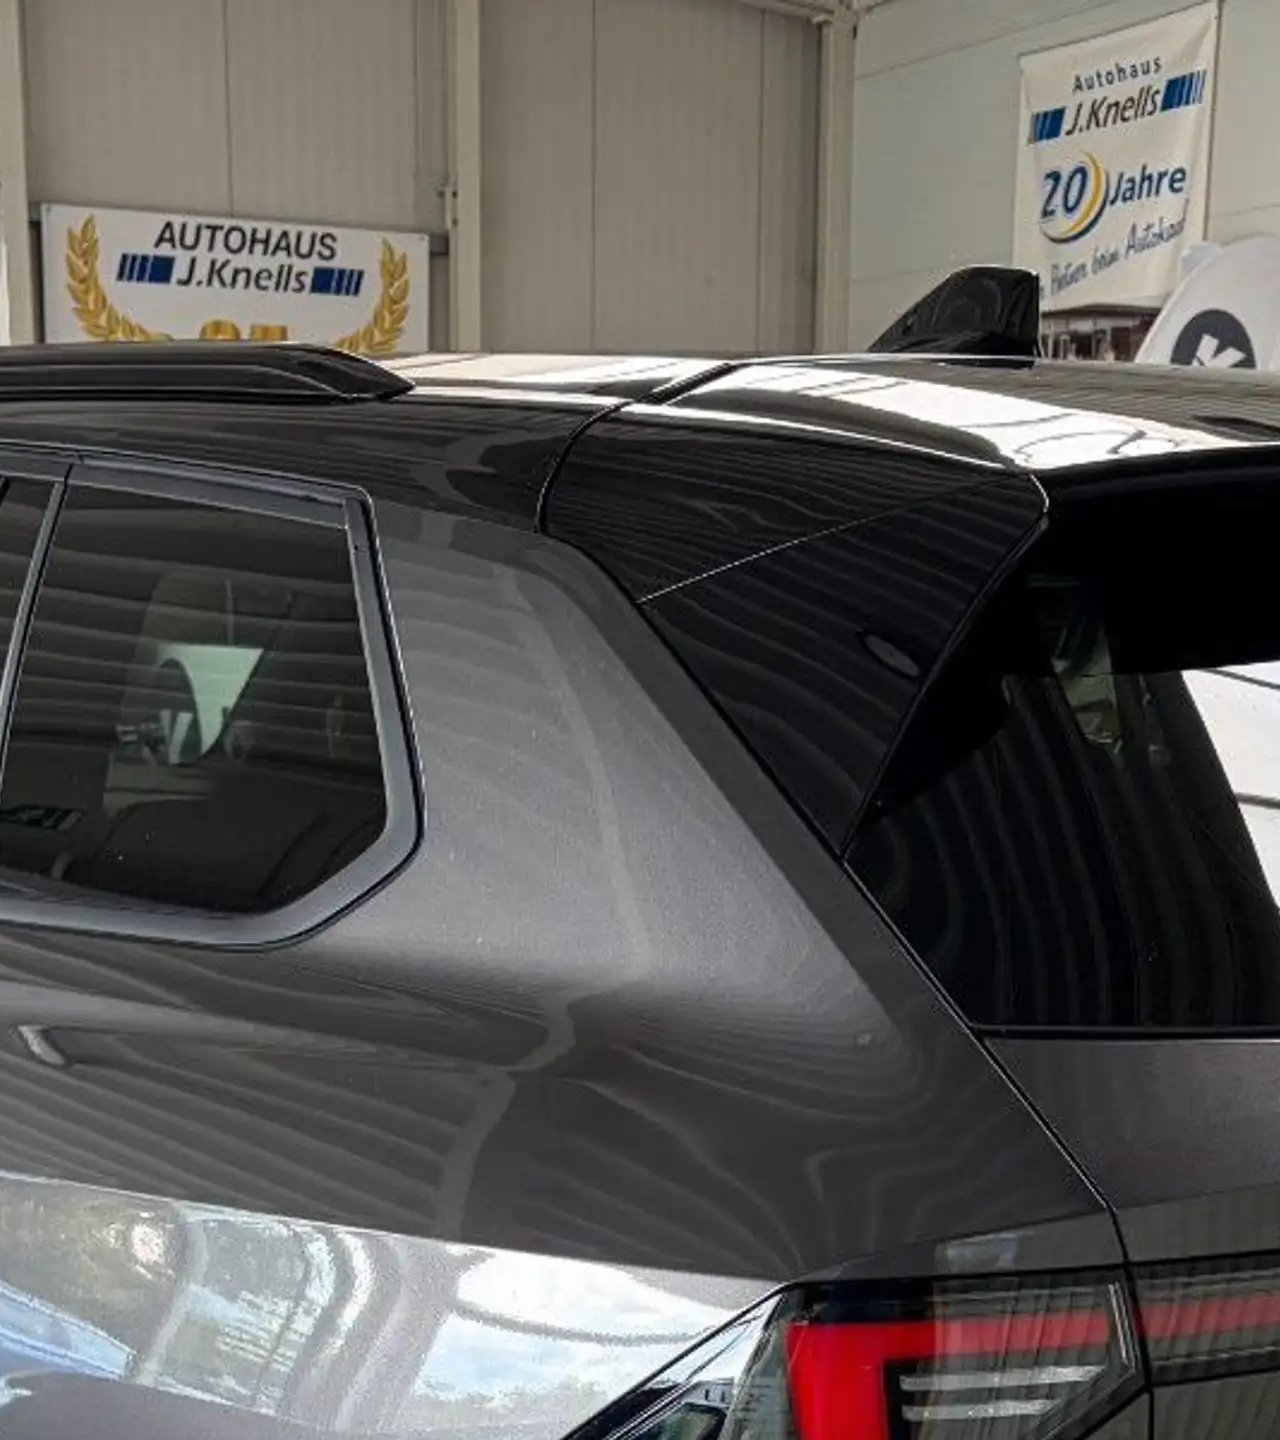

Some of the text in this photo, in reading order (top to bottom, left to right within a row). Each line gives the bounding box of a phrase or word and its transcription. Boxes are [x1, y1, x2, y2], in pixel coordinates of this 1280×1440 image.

[1072, 56, 1162, 95] Autohaus
[1065, 84, 1160, 136] J.Knells
[1041, 163, 1187, 218] 20 Jahre
[153, 220, 338, 262] AUTOHAUS
[176, 256, 309, 294] J.Knells
